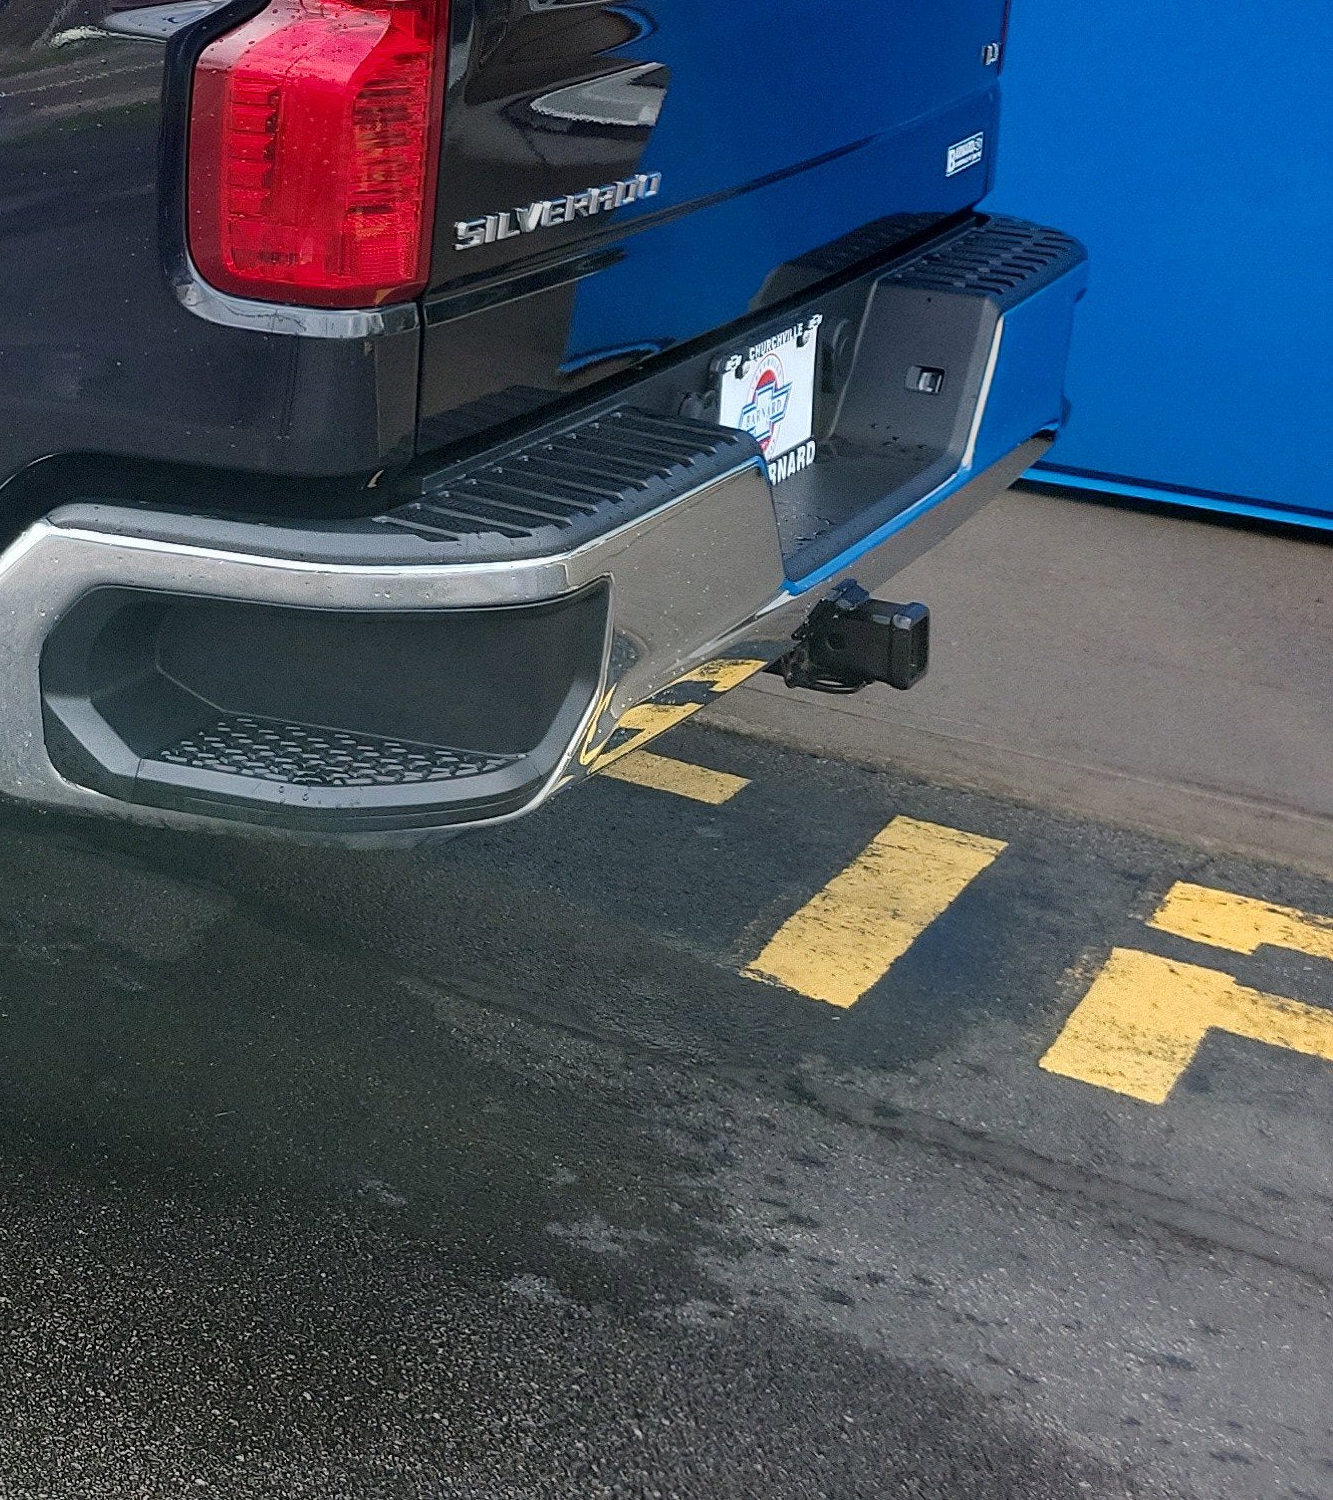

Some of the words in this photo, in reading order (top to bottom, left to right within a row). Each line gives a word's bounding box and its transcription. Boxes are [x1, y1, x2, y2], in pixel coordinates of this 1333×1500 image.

[453, 171, 663, 251] SILVERADO
[748, 322, 804, 360] CHURCHVILLE
[745, 398, 782, 428] BARNARD
